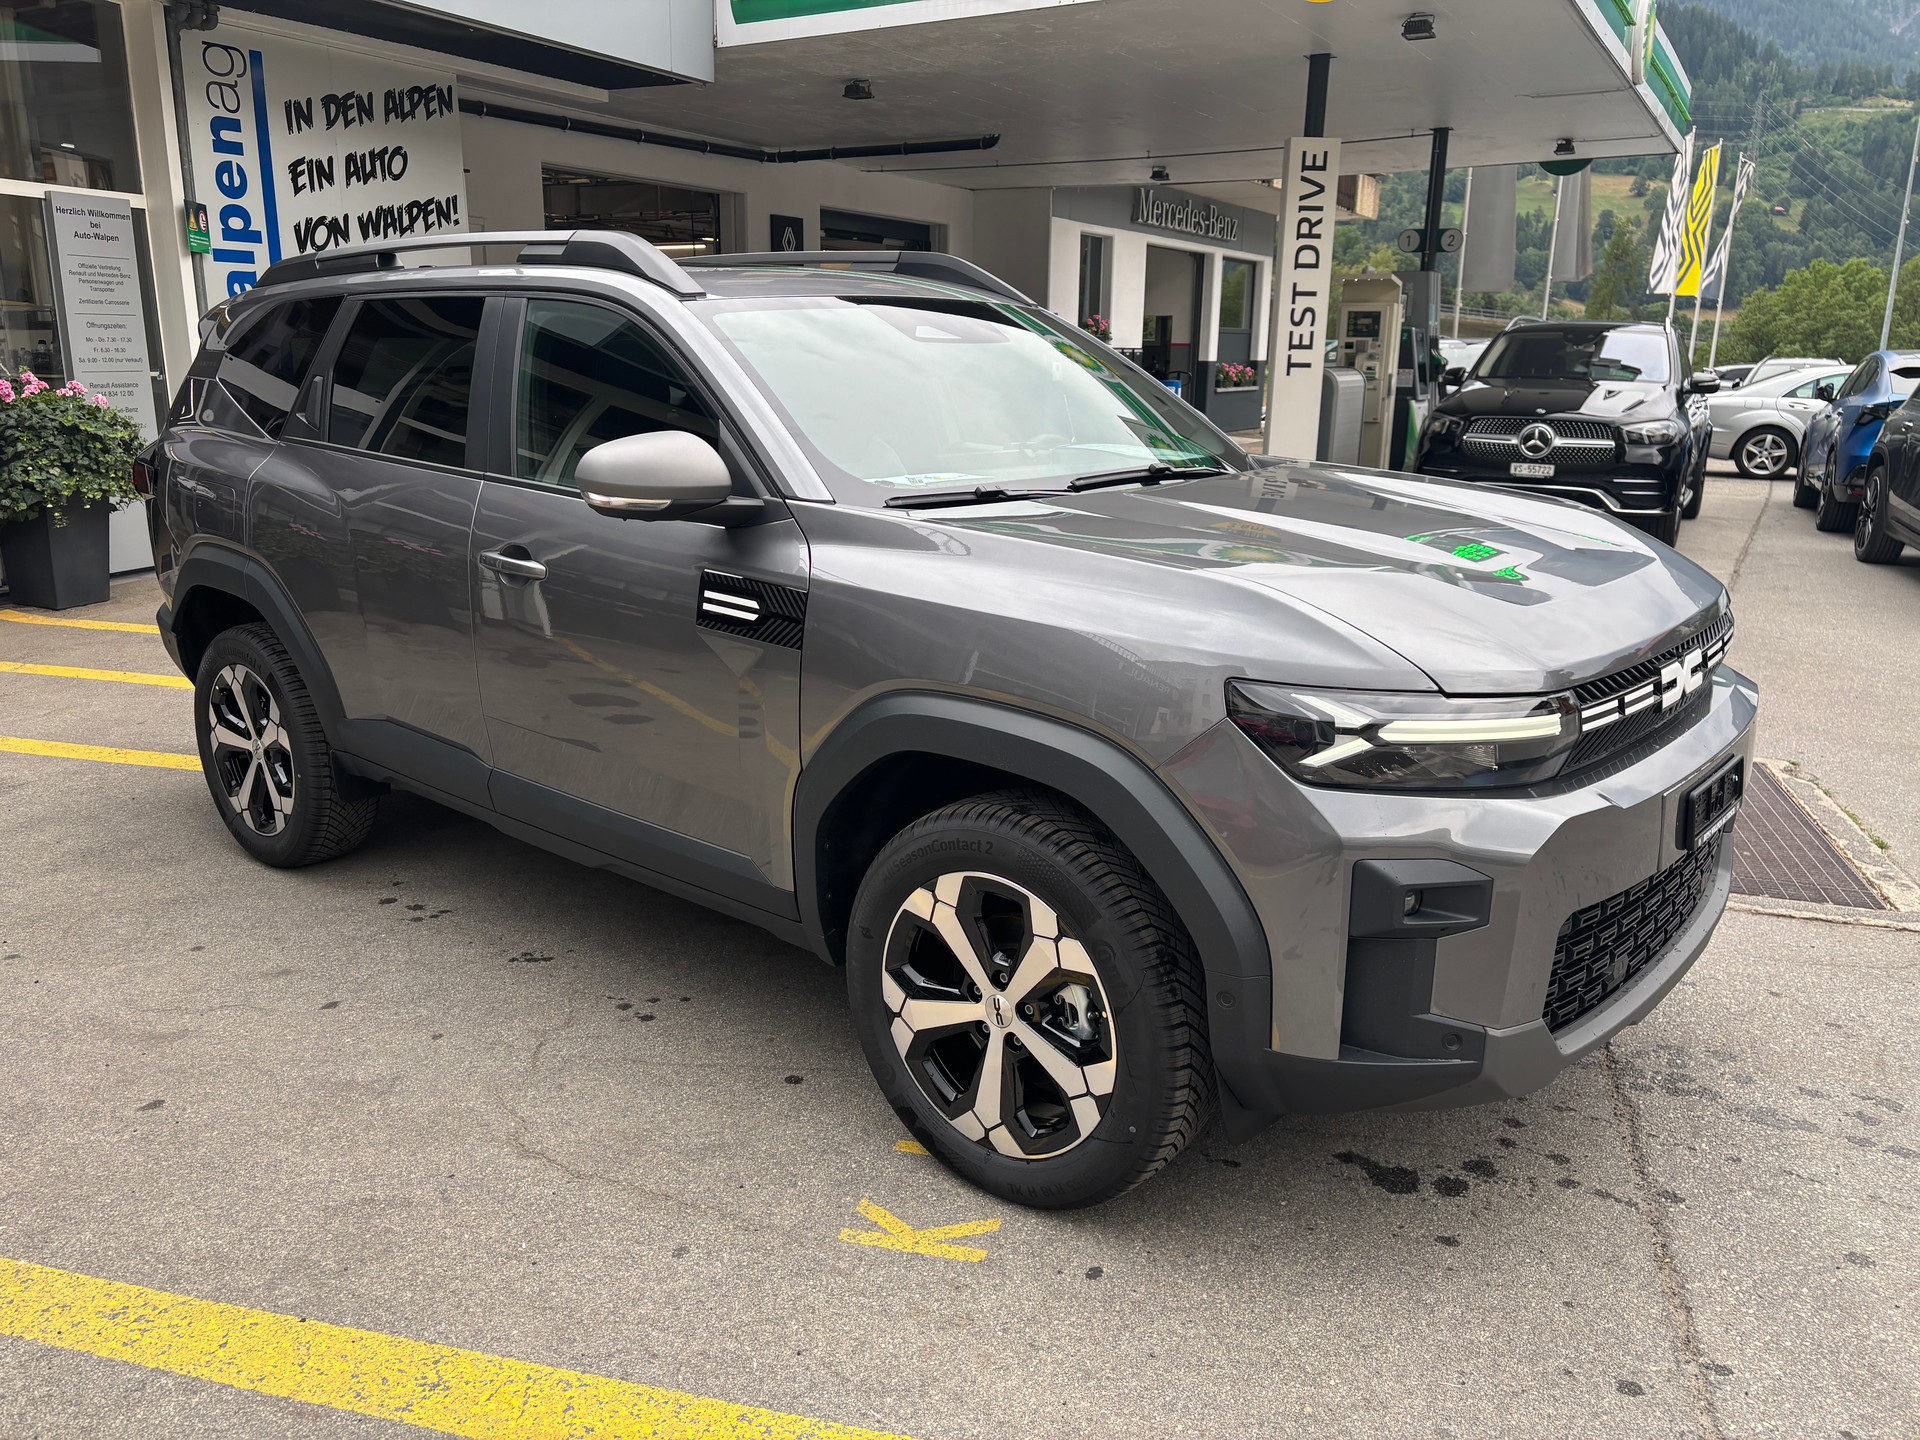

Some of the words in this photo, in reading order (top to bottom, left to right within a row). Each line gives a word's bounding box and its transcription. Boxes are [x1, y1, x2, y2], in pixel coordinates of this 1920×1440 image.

[284, 97, 313, 135] IN
[321, 91, 374, 131] DEN
[384, 84, 453, 125] ALPEN
[288, 156, 335, 197] EIN
[345, 146, 408, 189] AUTO
[55, 205, 86, 216] Herzlich
[87, 208, 131, 221] Willkommen
[1137, 187, 1239, 241] Mercedes-Benz
[1294, 150, 1328, 271] DRIVE
[89, 220, 102, 229] bei
[293, 213, 350, 254] VON
[357, 194, 460, 243] WALPEN!
[73, 230, 120, 243] Auto-Walpen
[1405, 235, 1411, 247] 1
[1447, 234, 1456, 247] 2
[77, 262, 98, 270] Offizielle
[98, 264, 122, 272] Vertretung
[68, 269, 87, 277] Renault
[97, 271, 131, 279] Mercedes-Benz
[78, 277, 115, 286] Personenwagen
[89, 285, 116, 293] Transporter
[78, 297, 104, 305] Zertifizierte
[104, 298, 130, 306] Carrosserie
[1286, 282, 1317, 376] TEST
[984, 840, 995, 856] 2
